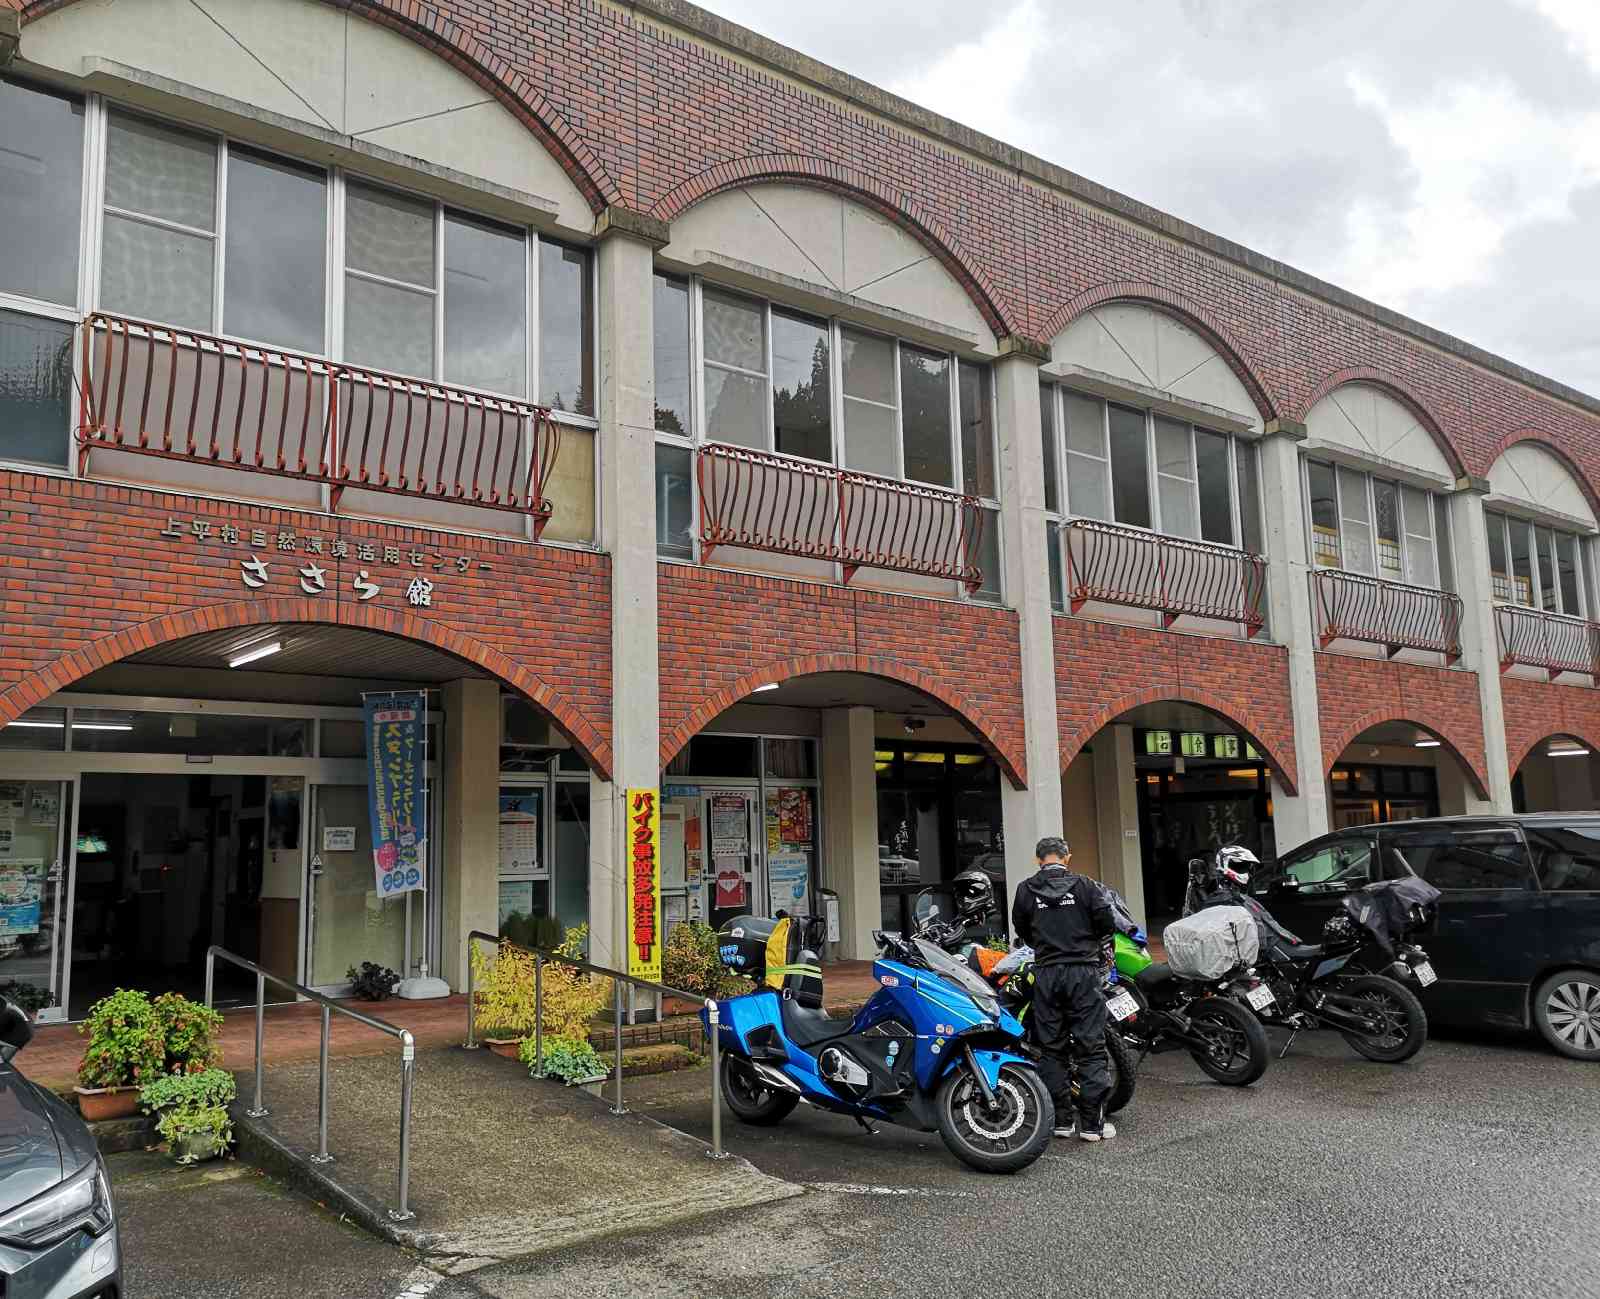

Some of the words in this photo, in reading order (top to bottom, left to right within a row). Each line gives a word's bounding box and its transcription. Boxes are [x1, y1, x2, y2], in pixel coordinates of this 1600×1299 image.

[160, 516, 493, 572] 上平村自然環境活用センター
[240, 554, 433, 606] ささら館
